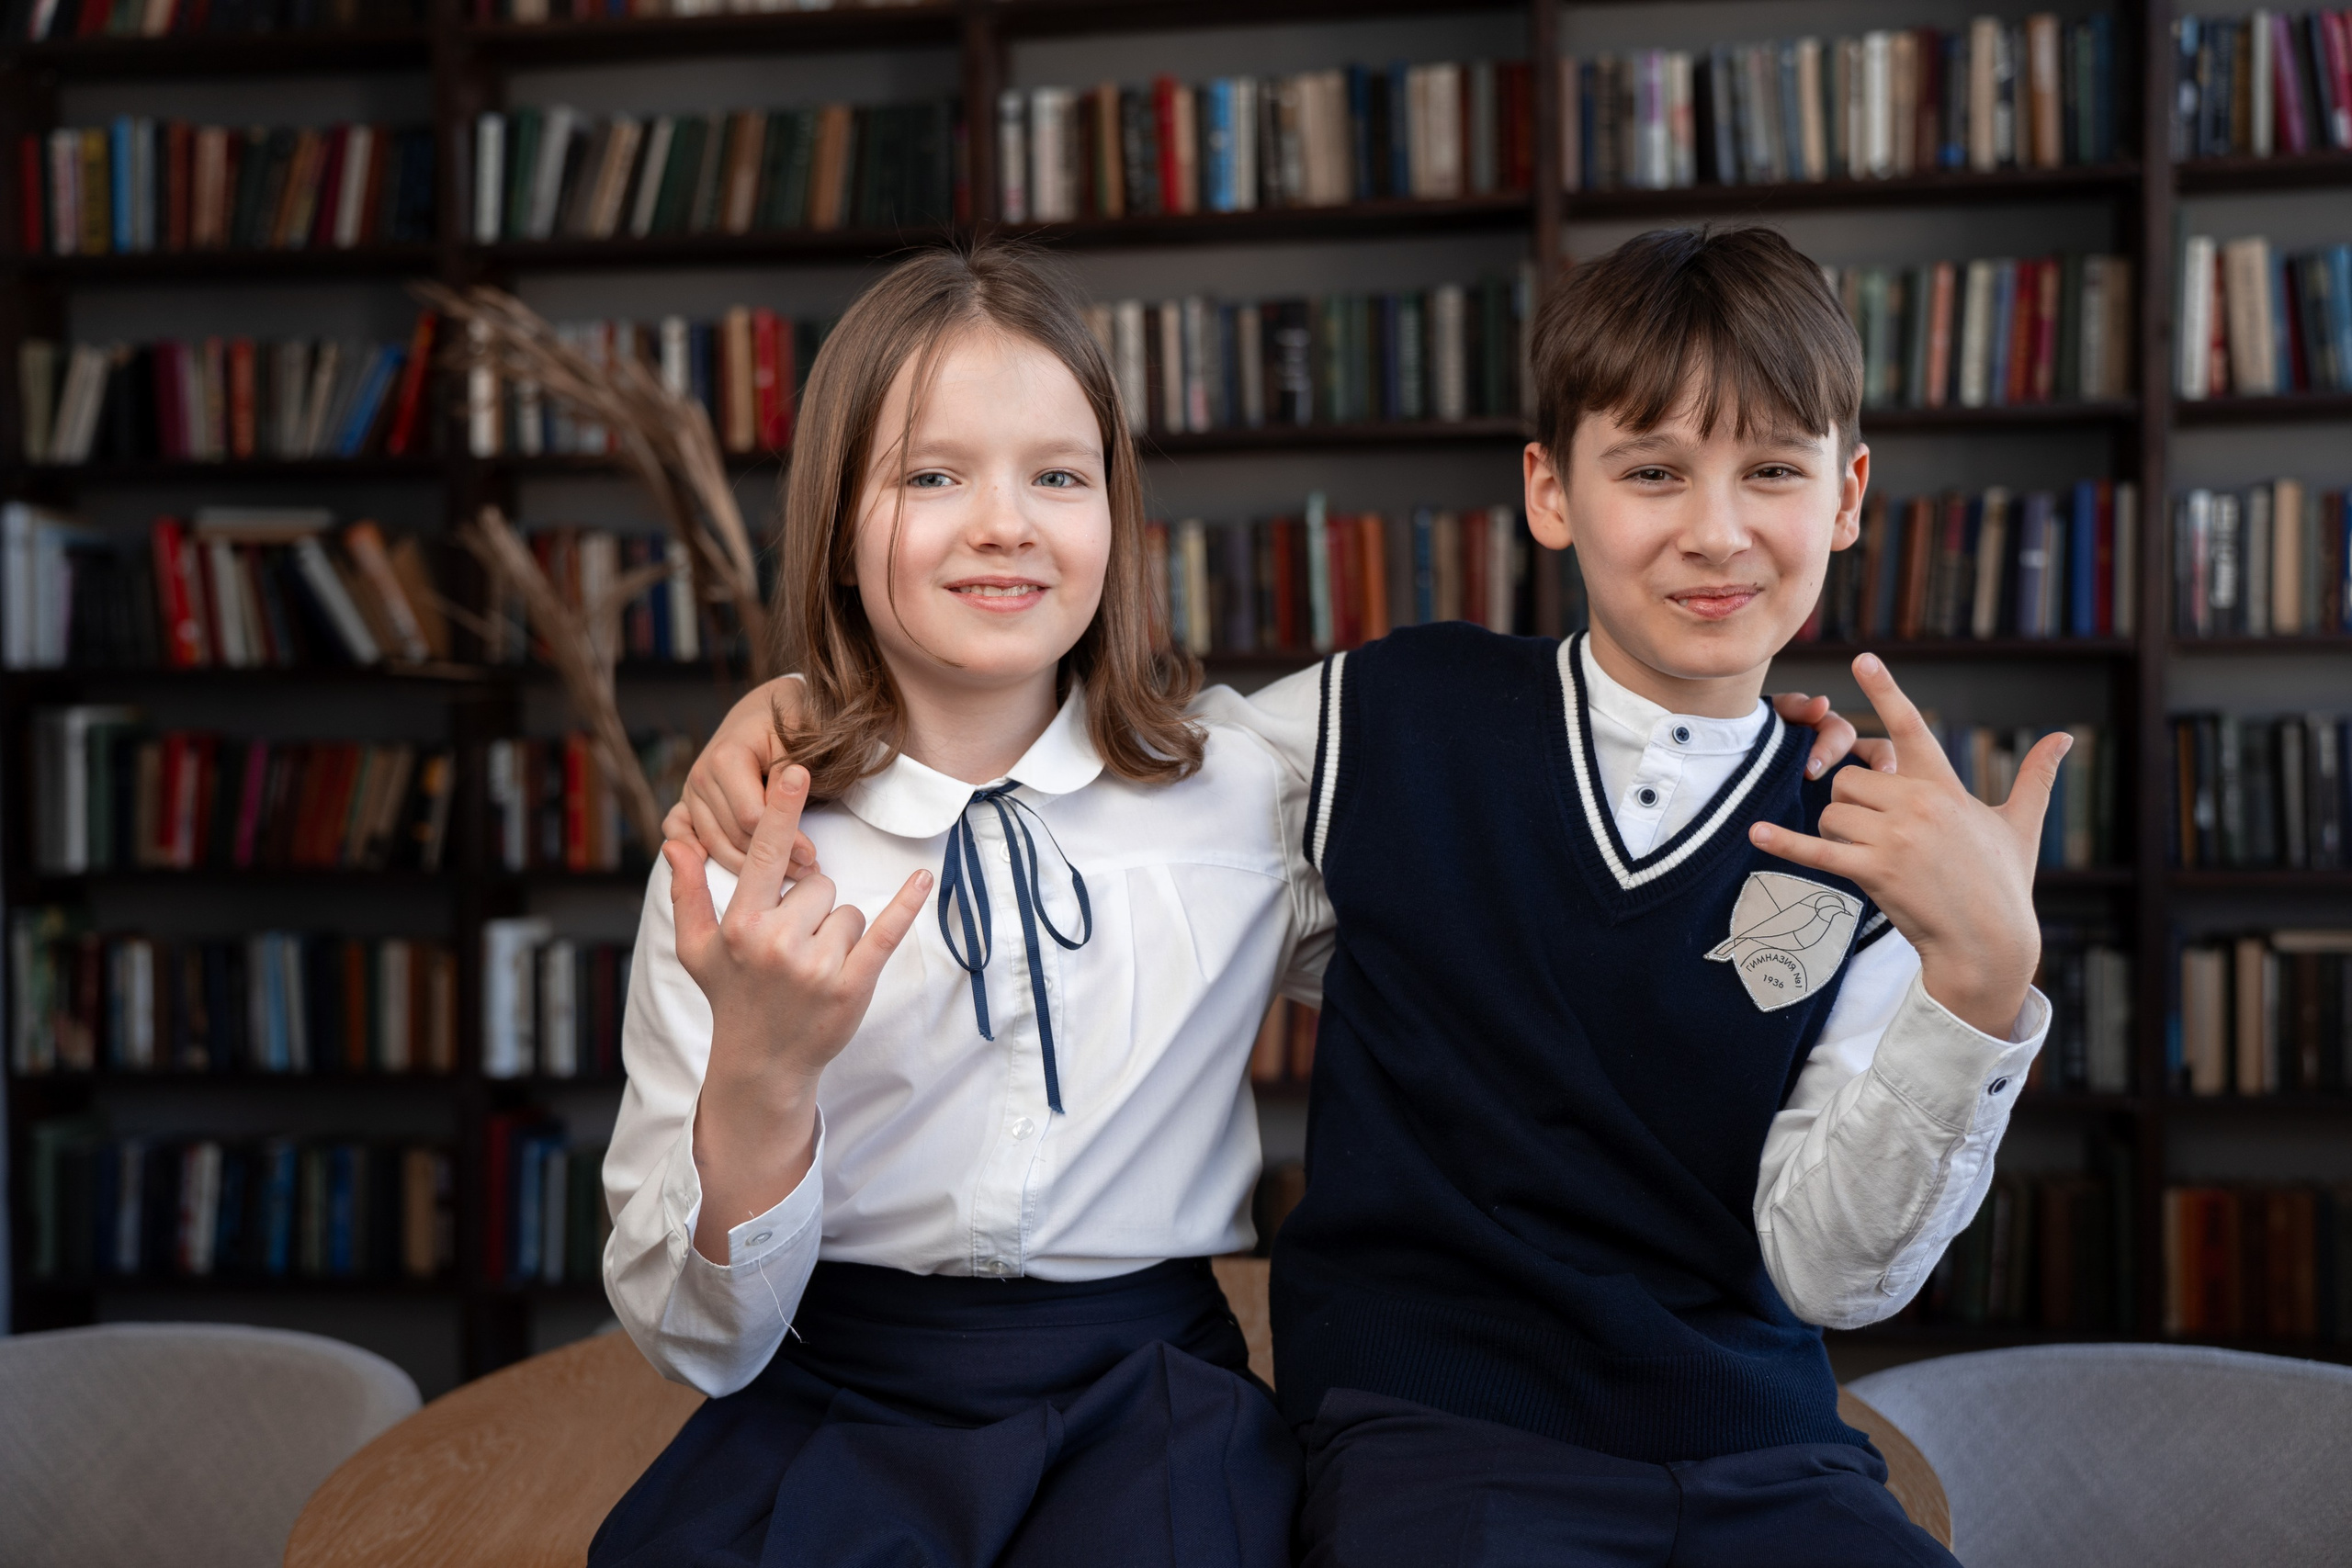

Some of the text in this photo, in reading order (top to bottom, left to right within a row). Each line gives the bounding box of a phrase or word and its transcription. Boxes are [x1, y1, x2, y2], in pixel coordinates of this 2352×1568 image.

[1746, 953, 1803, 988] ГИМНАЗИЯ №1
[1763, 975, 1784, 988] 1936
